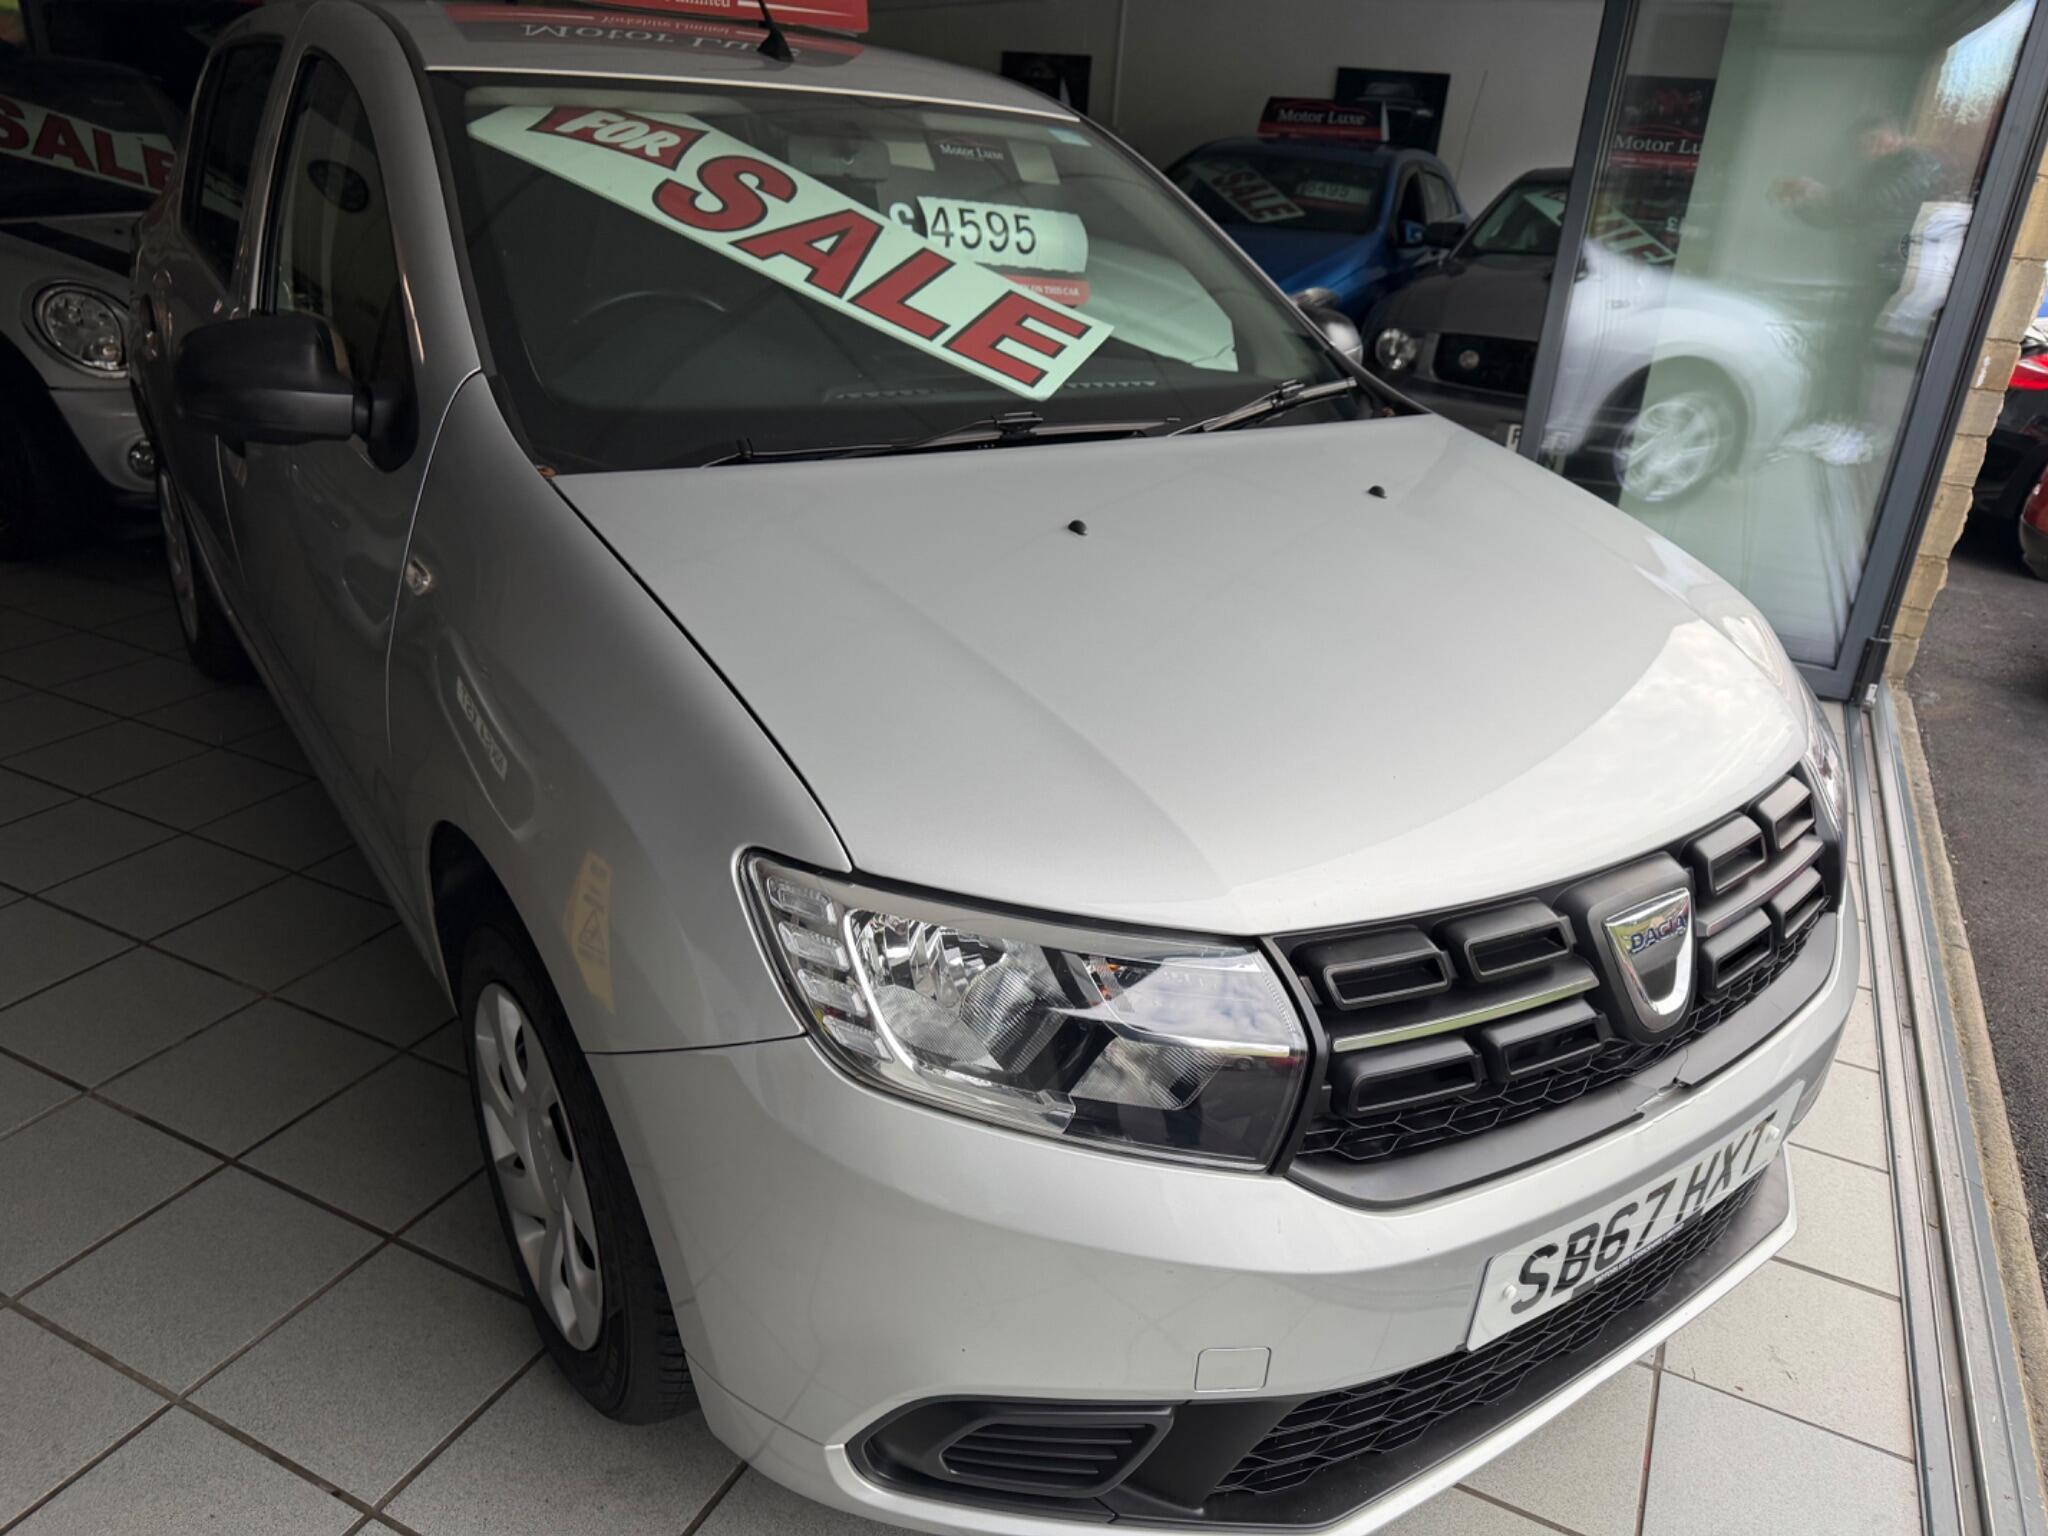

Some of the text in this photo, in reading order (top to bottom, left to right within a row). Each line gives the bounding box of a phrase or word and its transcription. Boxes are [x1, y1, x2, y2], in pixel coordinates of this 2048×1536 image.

[554, 110, 681, 157] FOR
[1277, 108, 1366, 125] Motor Luxe
[1614, 134, 1701, 154] Motor Lu
[652, 155, 1092, 388] SALE
[1630, 915, 1688, 953] DACIA
[1510, 1176, 1678, 1315] SB67
[1674, 1109, 1778, 1225] HXT
